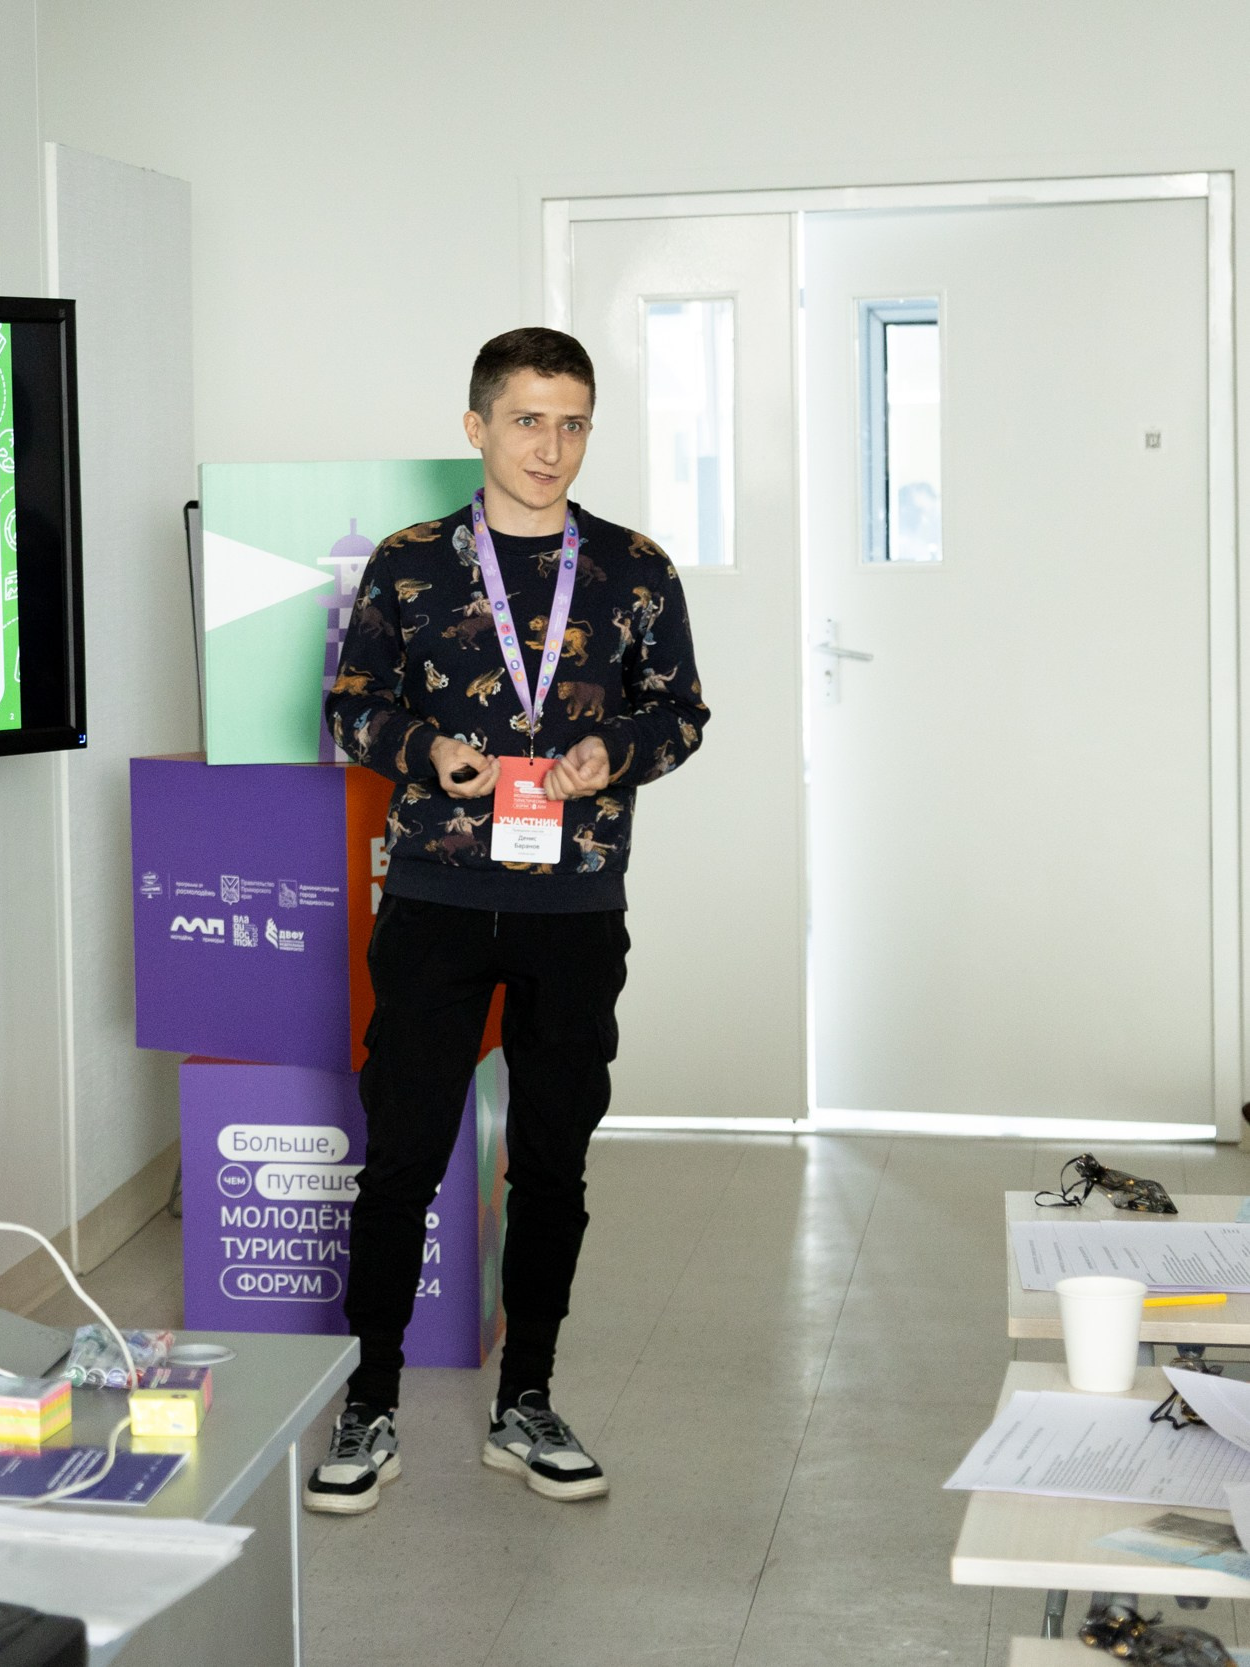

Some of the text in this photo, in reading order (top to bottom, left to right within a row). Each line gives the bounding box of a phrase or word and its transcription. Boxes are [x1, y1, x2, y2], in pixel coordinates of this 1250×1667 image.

[499, 816, 558, 827] УЧАСТНИК
[279, 930, 305, 940] ДВФУ
[233, 1131, 336, 1157] Больше,
[224, 1173, 357, 1195] ЧЕМ путеше
[220, 1204, 352, 1234] МОЛОДЁЖ
[236, 1273, 442, 1298] ФОРУМ 24
